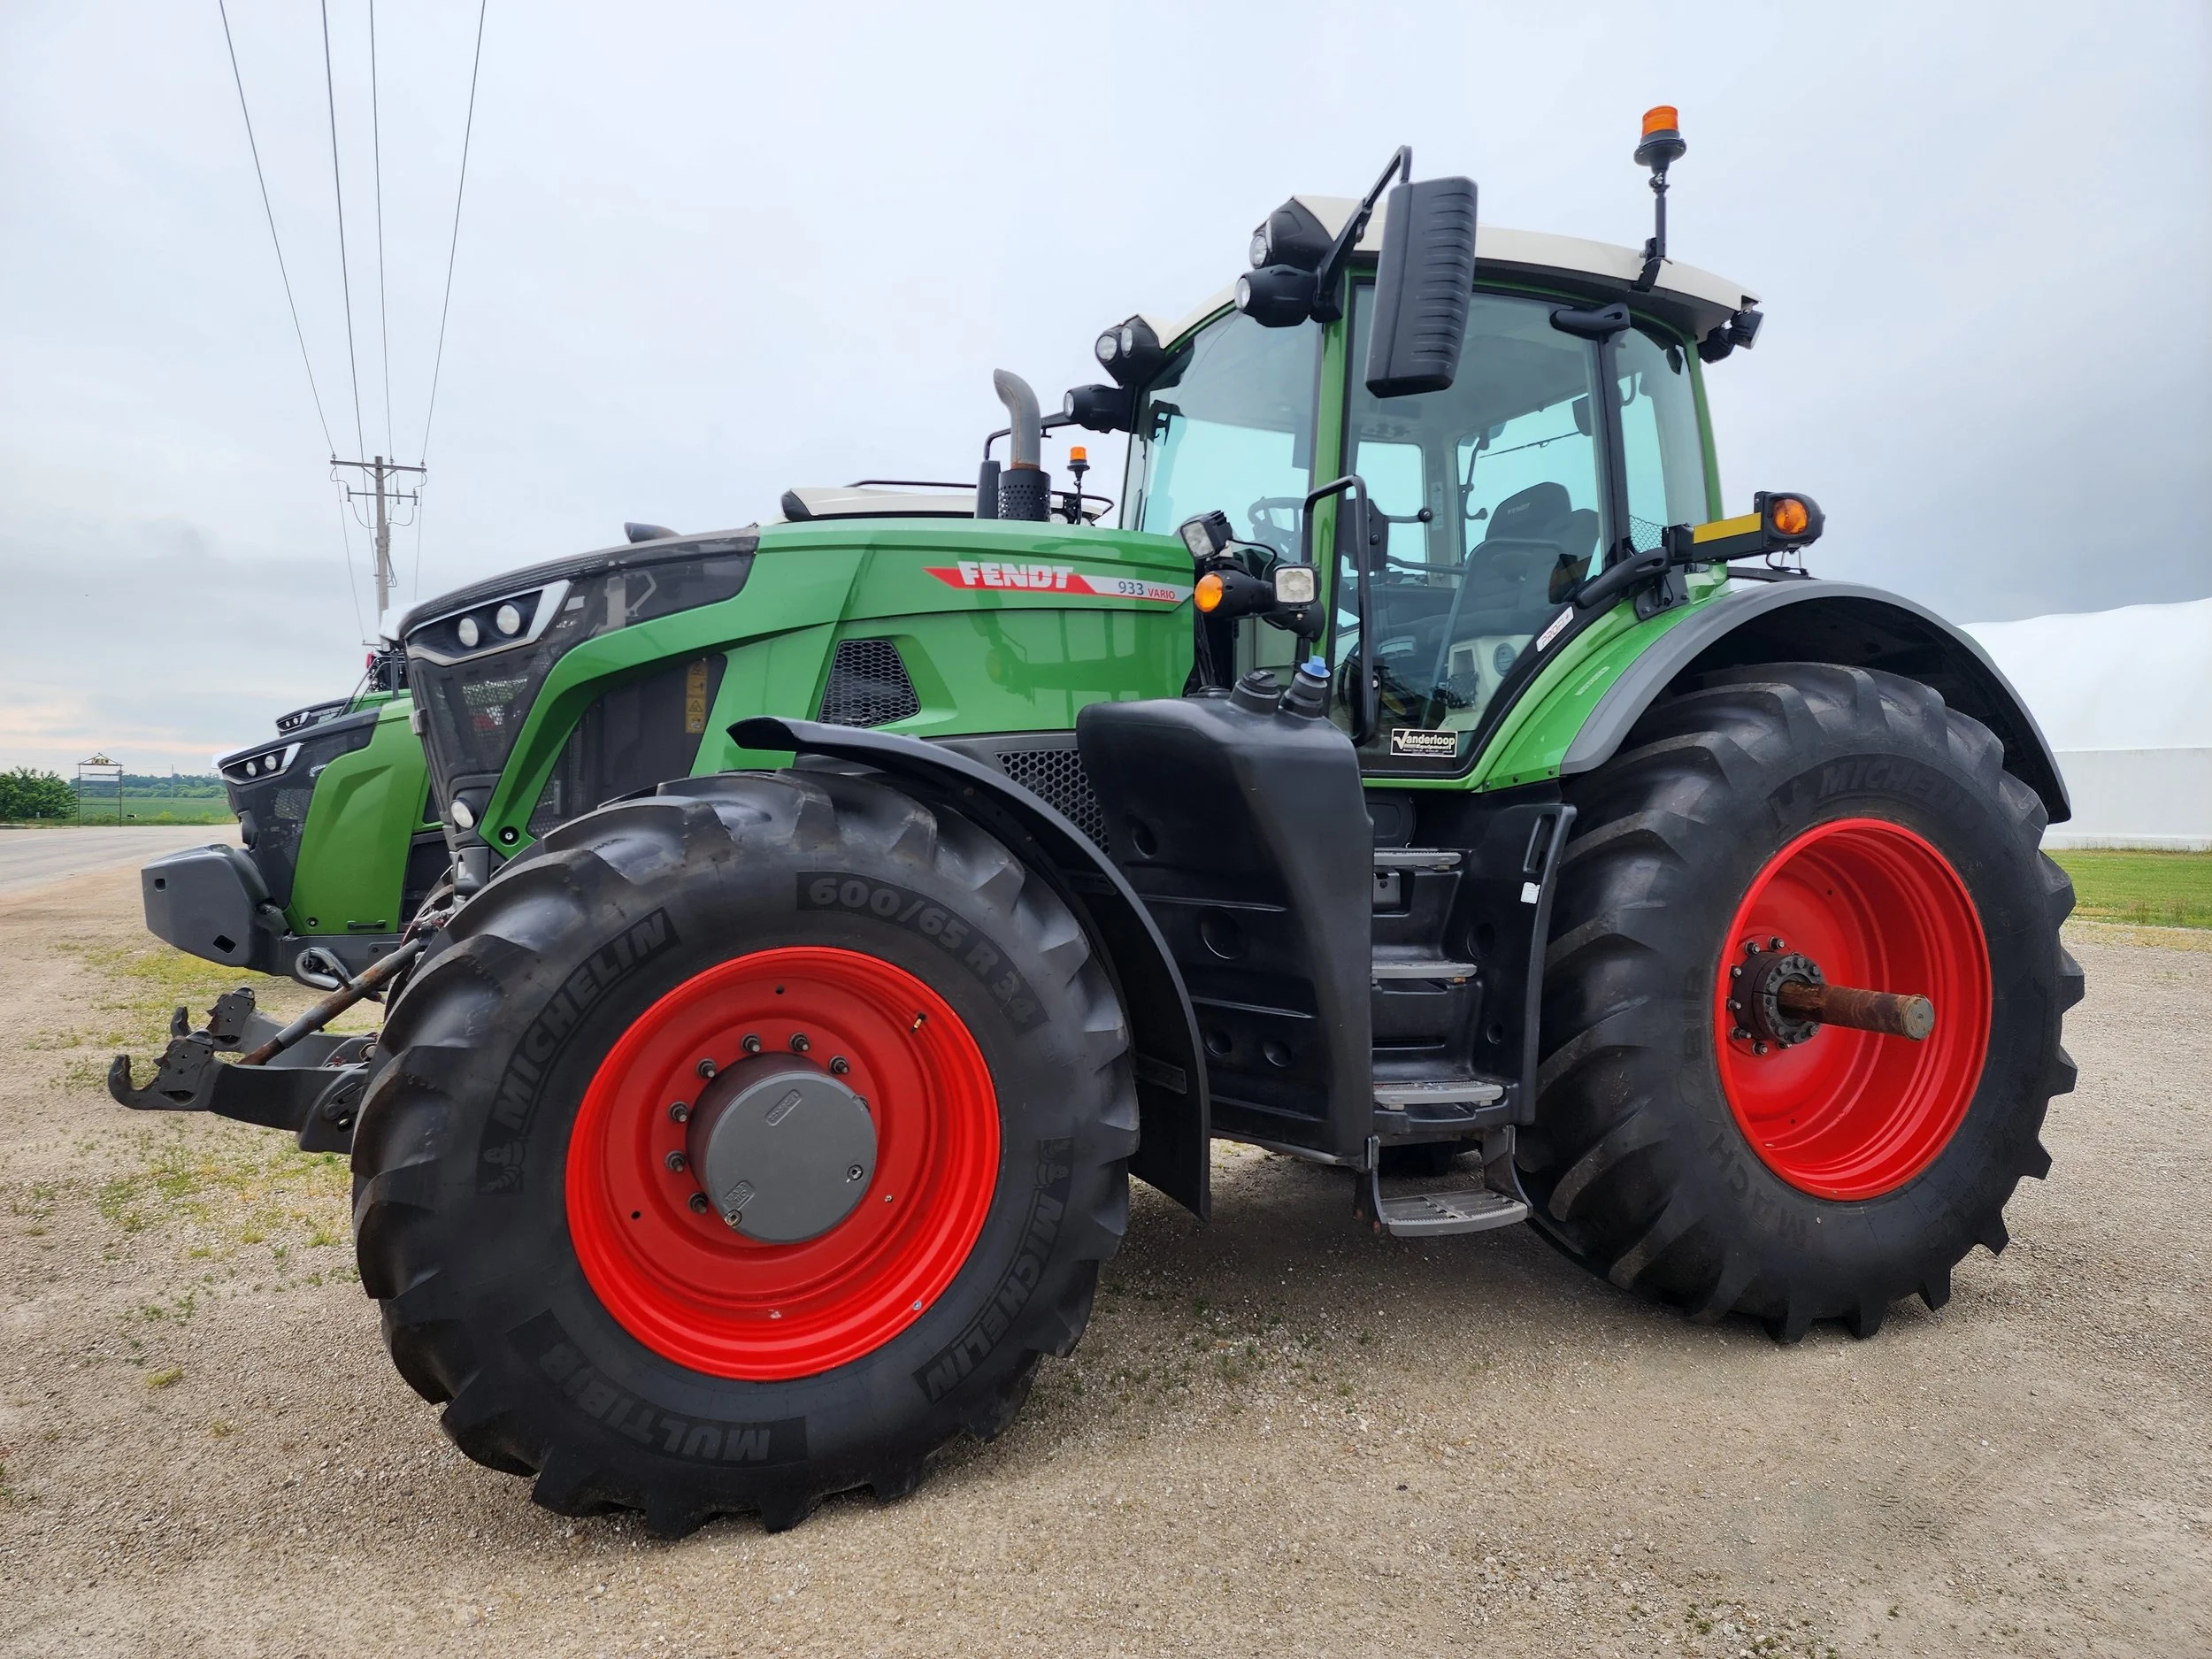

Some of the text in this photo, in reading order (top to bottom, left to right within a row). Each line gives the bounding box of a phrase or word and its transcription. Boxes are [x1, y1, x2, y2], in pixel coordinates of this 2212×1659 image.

[957, 561, 1176, 600] FENDT 933 VARIO
[1394, 731, 1455, 750] Vanderloop
[809, 877, 1039, 1025] 600/65 R 34
[492, 911, 667, 1132] MICHELIN
[926, 1194, 1065, 1402] MICHELIN
[538, 1342, 772, 1462] MULTIBIB
